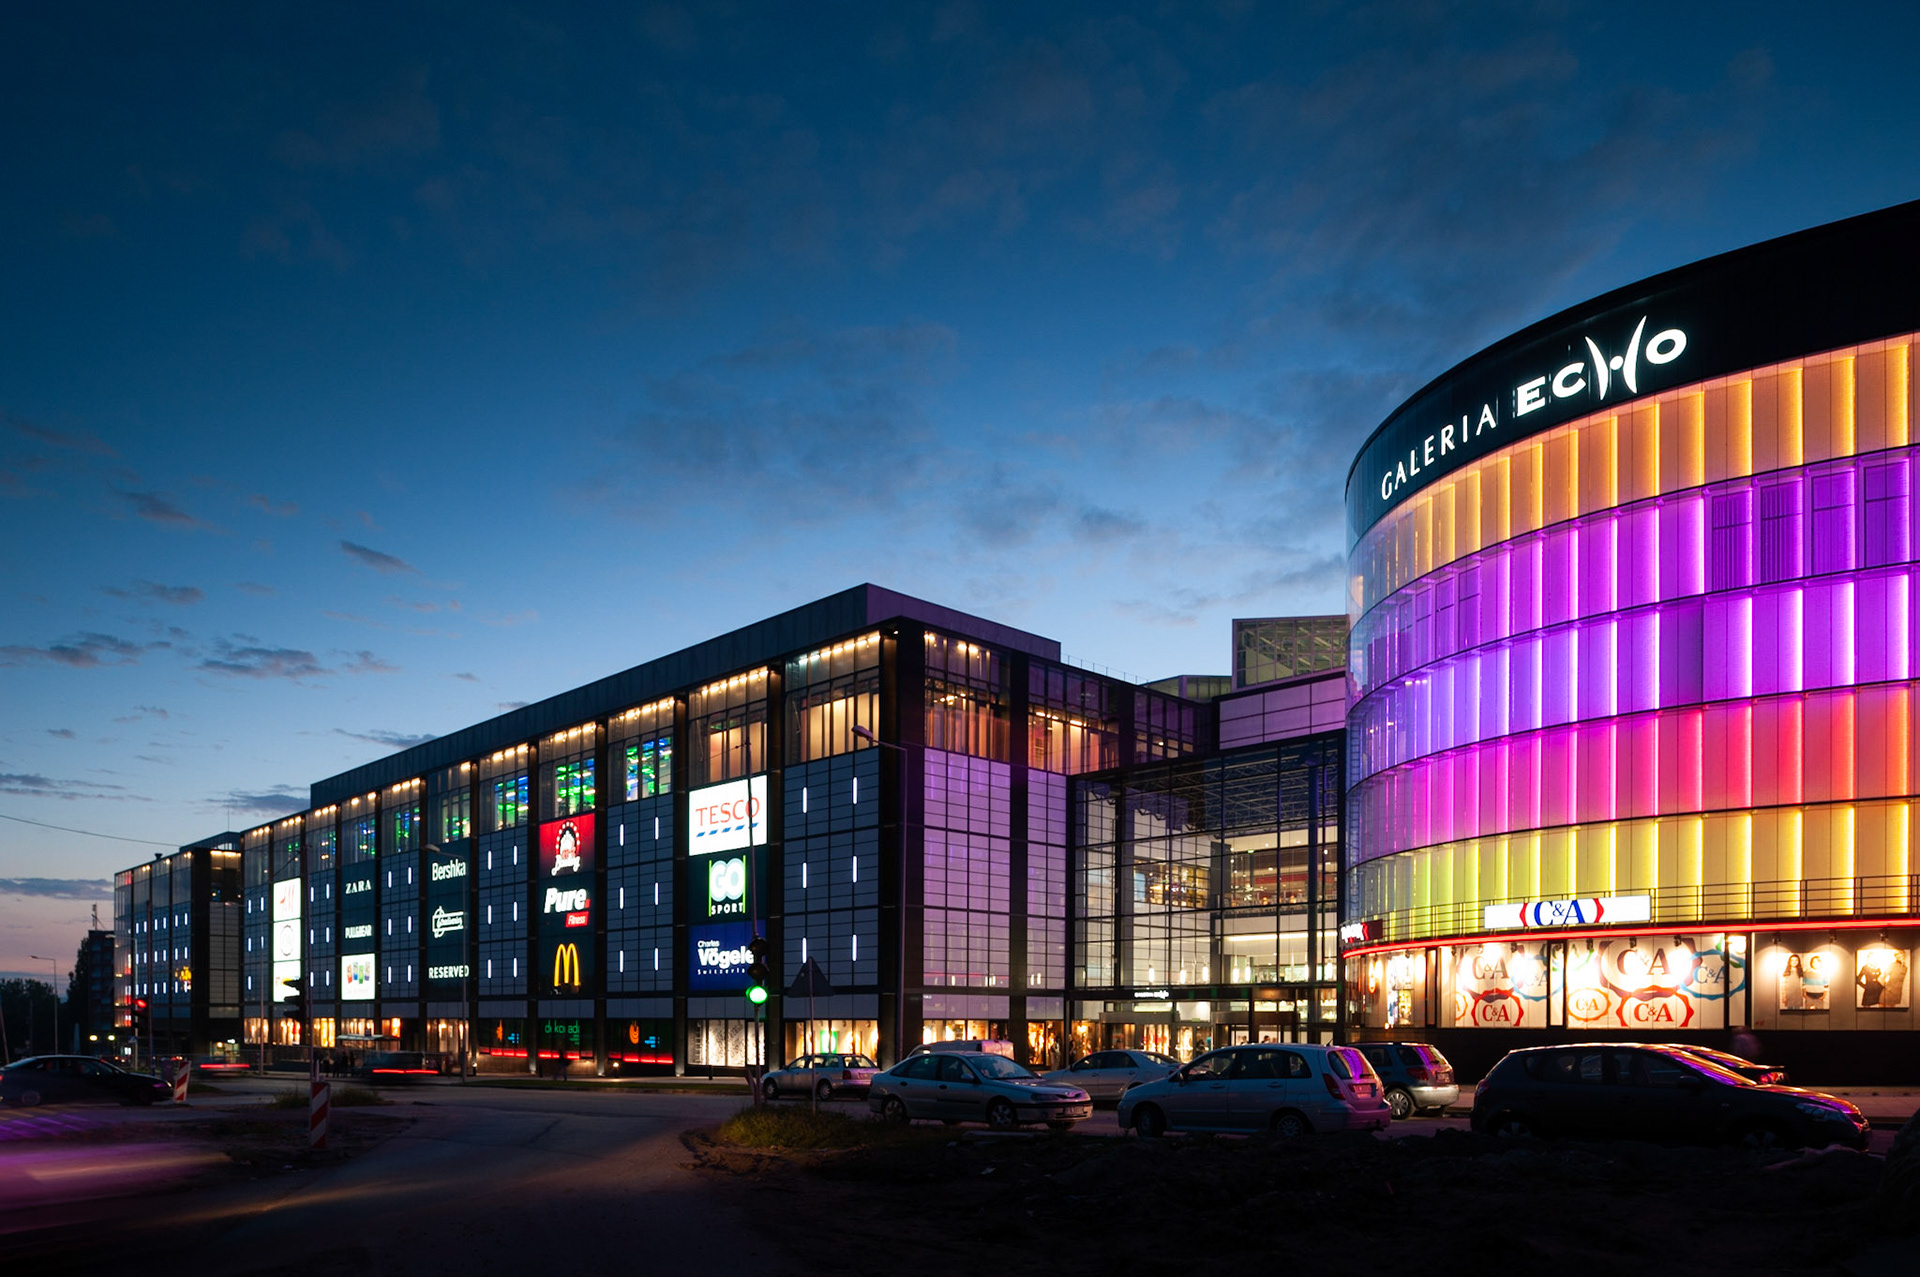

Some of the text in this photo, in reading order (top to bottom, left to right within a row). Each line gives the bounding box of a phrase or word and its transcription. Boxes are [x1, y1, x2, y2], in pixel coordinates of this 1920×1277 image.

[1381, 315, 1688, 501] GALERIA ECHO
[695, 796, 760, 827] TESCO
[432, 859, 466, 881] Bershka
[710, 857, 745, 902] GO
[346, 880, 372, 894] ZARA
[711, 902, 744, 915] SPORT
[1534, 900, 1586, 926] C&A
[568, 915, 586, 925] Fitness
[428, 964, 470, 979] RESERVED
[1482, 1003, 1511, 1022] C&A
[1633, 1002, 1674, 1022] C&A
